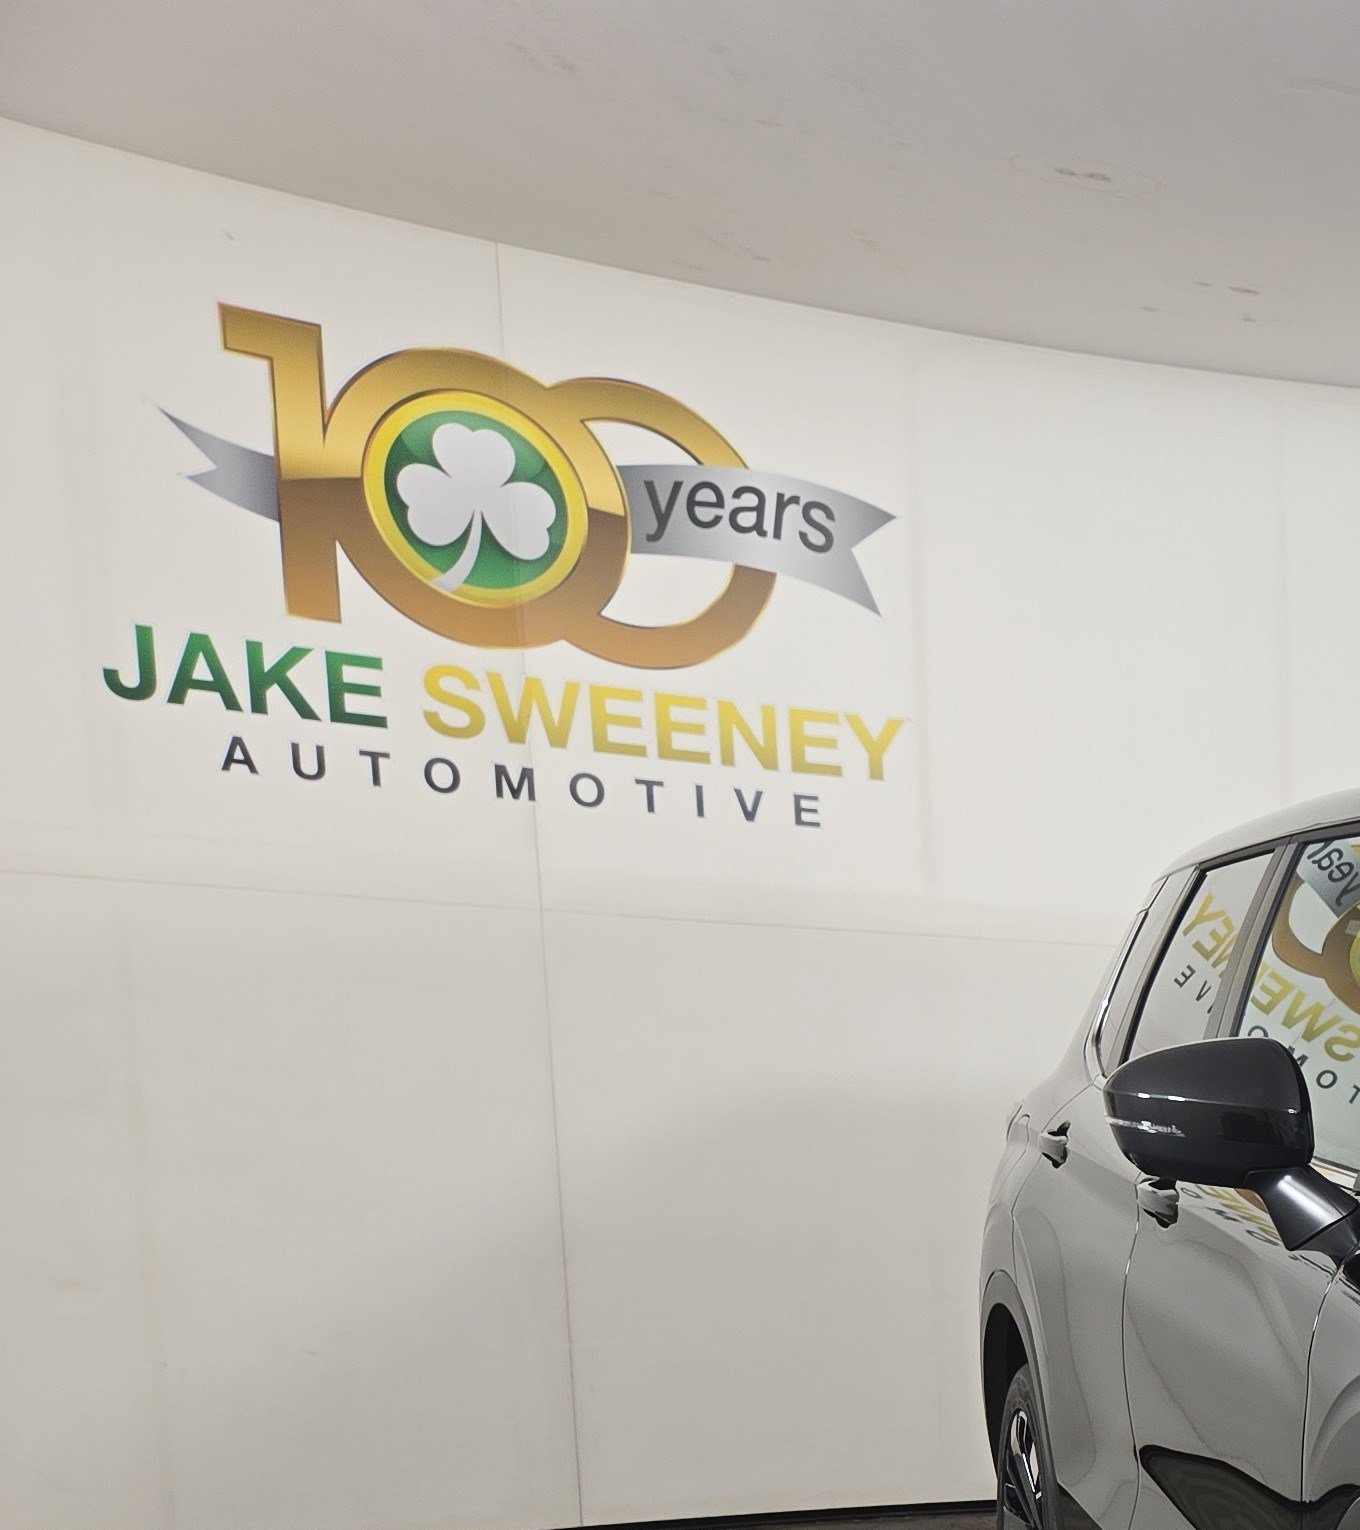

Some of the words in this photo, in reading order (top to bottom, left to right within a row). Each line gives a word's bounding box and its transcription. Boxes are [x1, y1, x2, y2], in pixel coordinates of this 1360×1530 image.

[643, 477, 836, 553] years
[103, 622, 390, 729] JAKE
[422, 662, 908, 782] SWEENEY
[220, 734, 823, 829] AUTOMOTIVE
